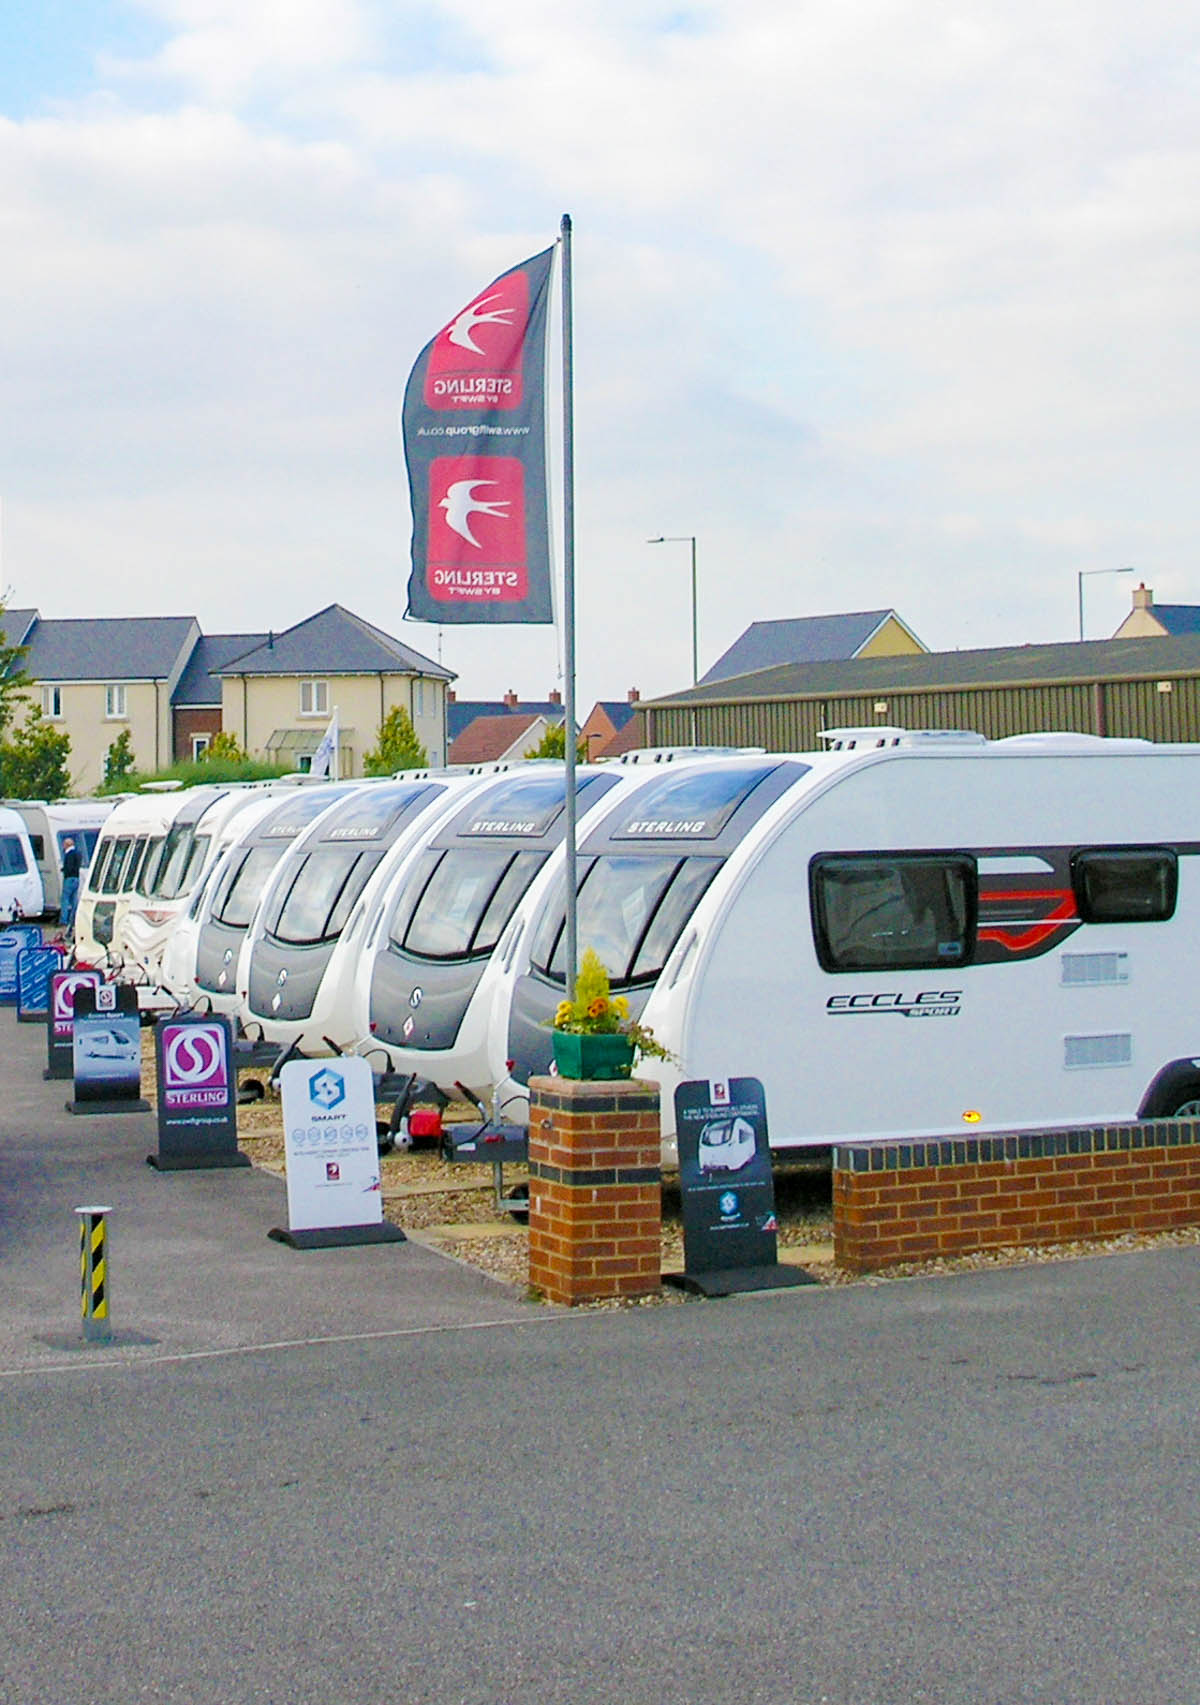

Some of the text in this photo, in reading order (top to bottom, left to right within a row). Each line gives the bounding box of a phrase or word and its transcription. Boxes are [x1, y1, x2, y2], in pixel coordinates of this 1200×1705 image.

[471, 820, 536, 833] STERLING
[627, 820, 706, 833] STERLING
[826, 991, 963, 1008] ECCLES
[909, 1006, 961, 1017] SPORT
[168, 1091, 225, 1104] STERLING
